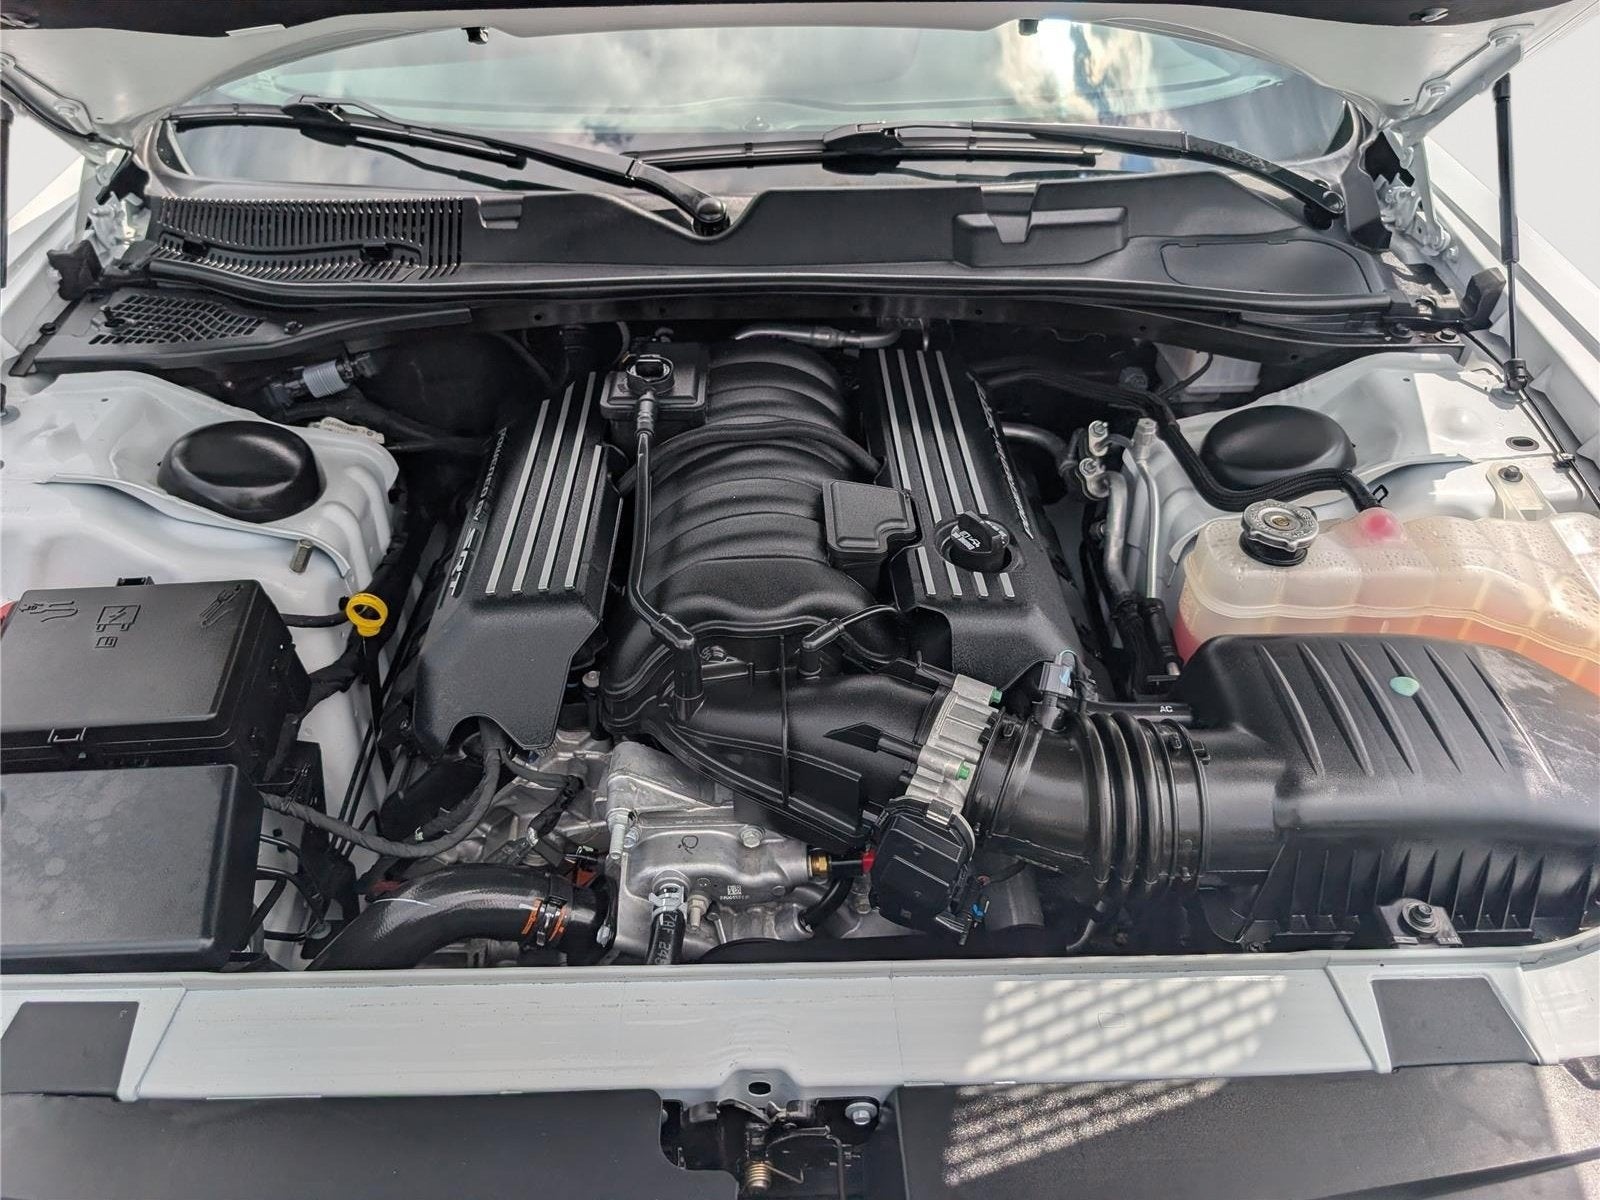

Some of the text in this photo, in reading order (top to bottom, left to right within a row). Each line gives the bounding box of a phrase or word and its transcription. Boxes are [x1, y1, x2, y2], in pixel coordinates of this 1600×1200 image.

[449, 527, 476, 596] SRT
[1159, 705, 1174, 713] AC
[661, 910, 679, 935] 7AF
